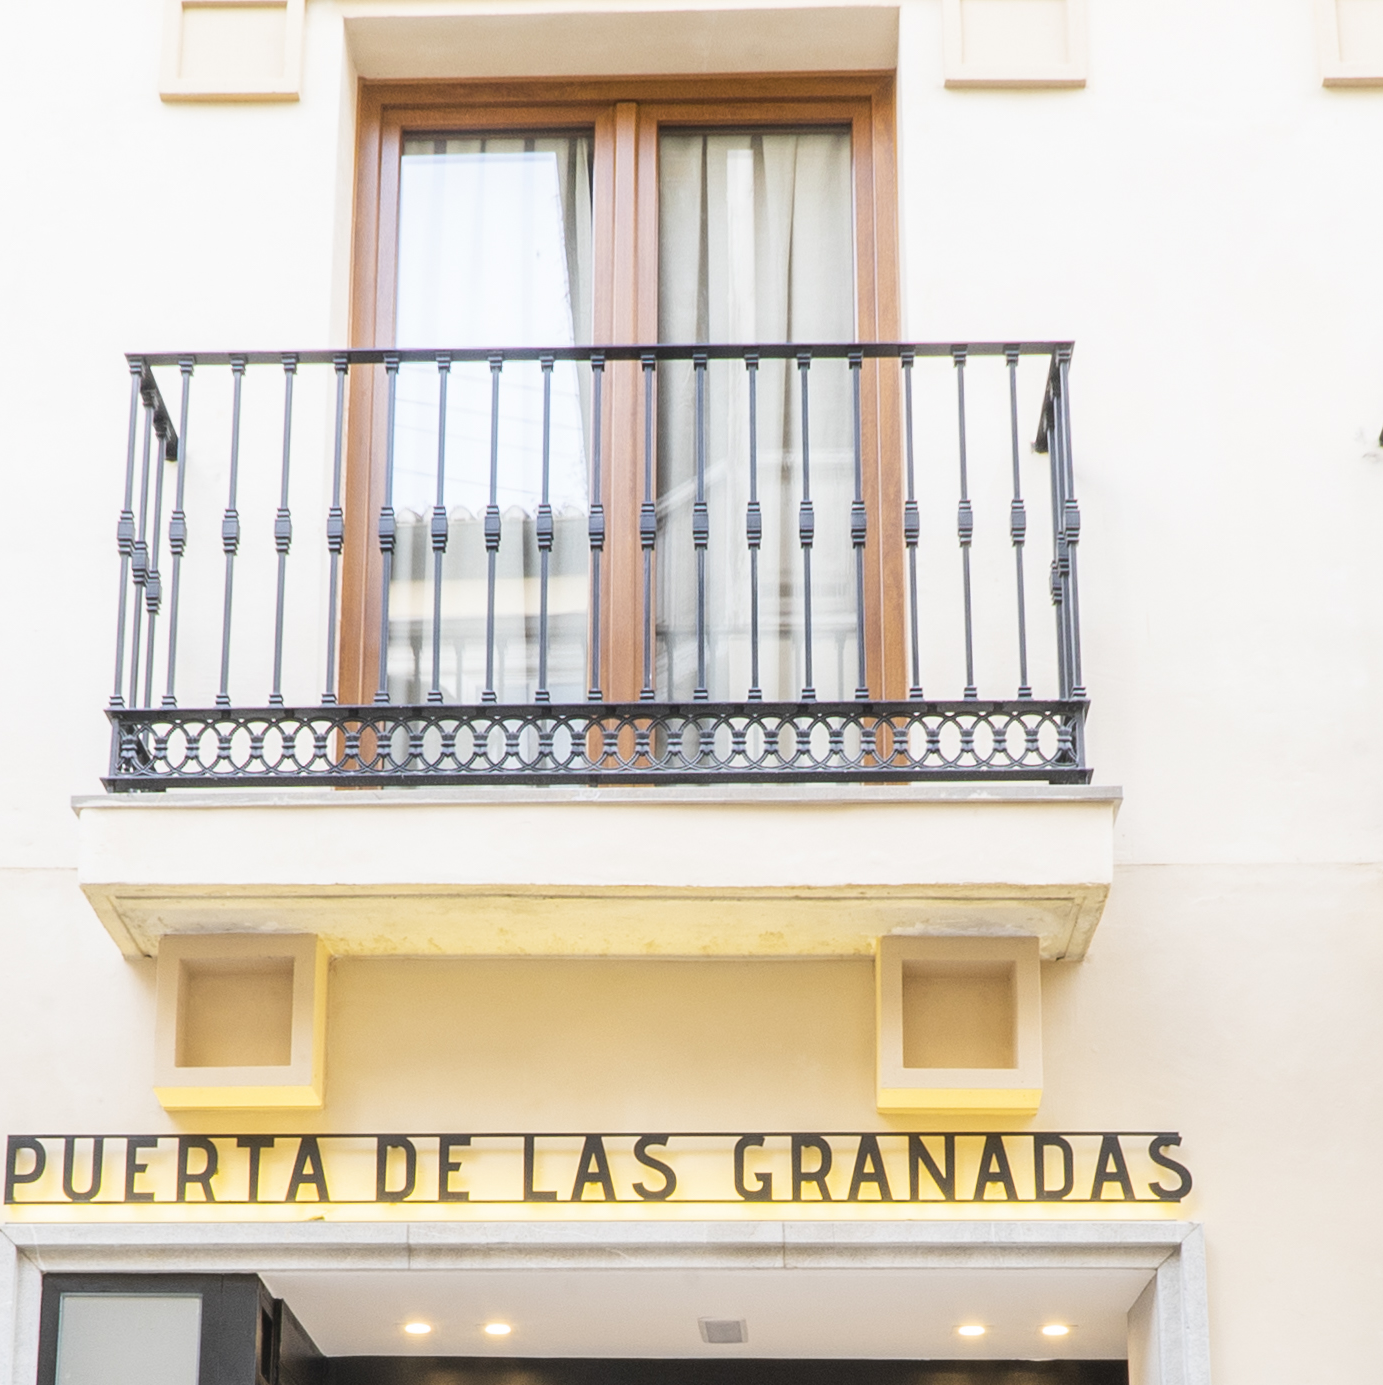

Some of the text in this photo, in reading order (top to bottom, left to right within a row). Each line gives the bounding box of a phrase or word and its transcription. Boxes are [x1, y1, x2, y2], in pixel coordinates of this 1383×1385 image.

[4, 1133, 1193, 1204] PUERTA DE LAS GRANADAS
